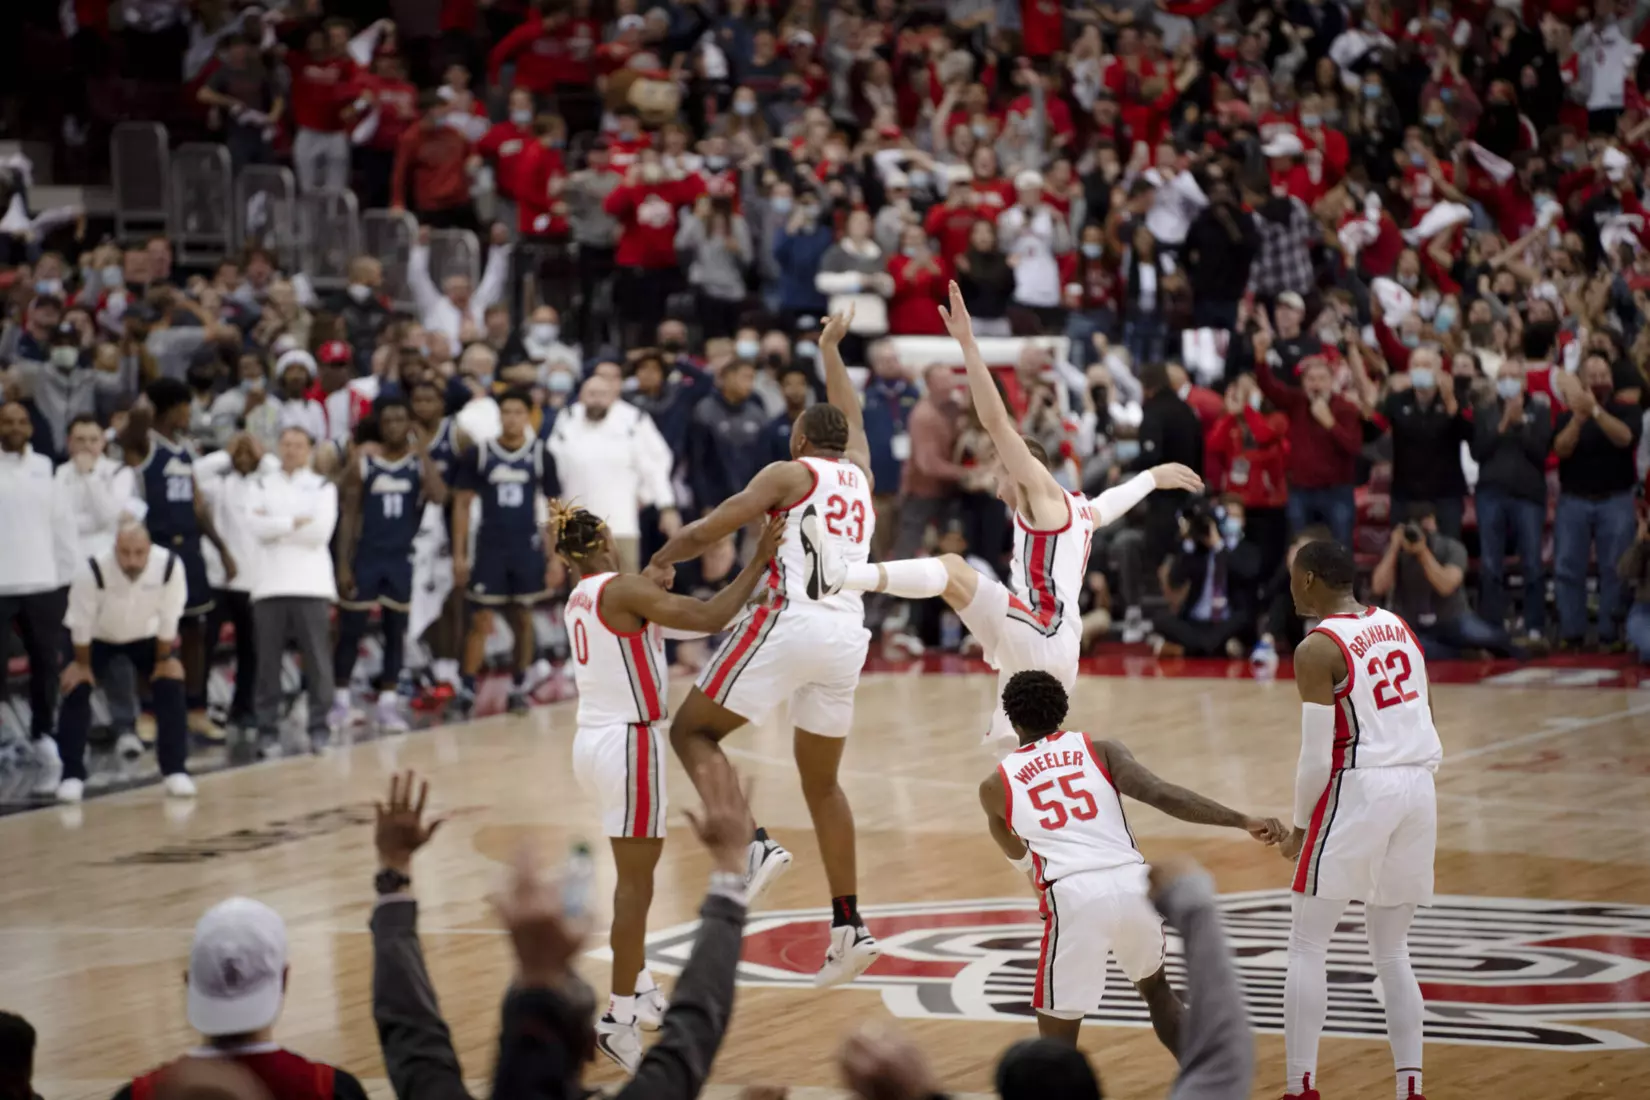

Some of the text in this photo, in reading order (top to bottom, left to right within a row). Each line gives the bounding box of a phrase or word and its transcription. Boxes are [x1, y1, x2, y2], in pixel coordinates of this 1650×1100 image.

[825, 494, 865, 544] 23
[574, 618, 588, 665] 0
[1349, 624, 1407, 659] BRANHAM
[1367, 649, 1420, 710] 22
[1014, 750, 1084, 785] WHEELER
[1027, 771, 1098, 831] 55
